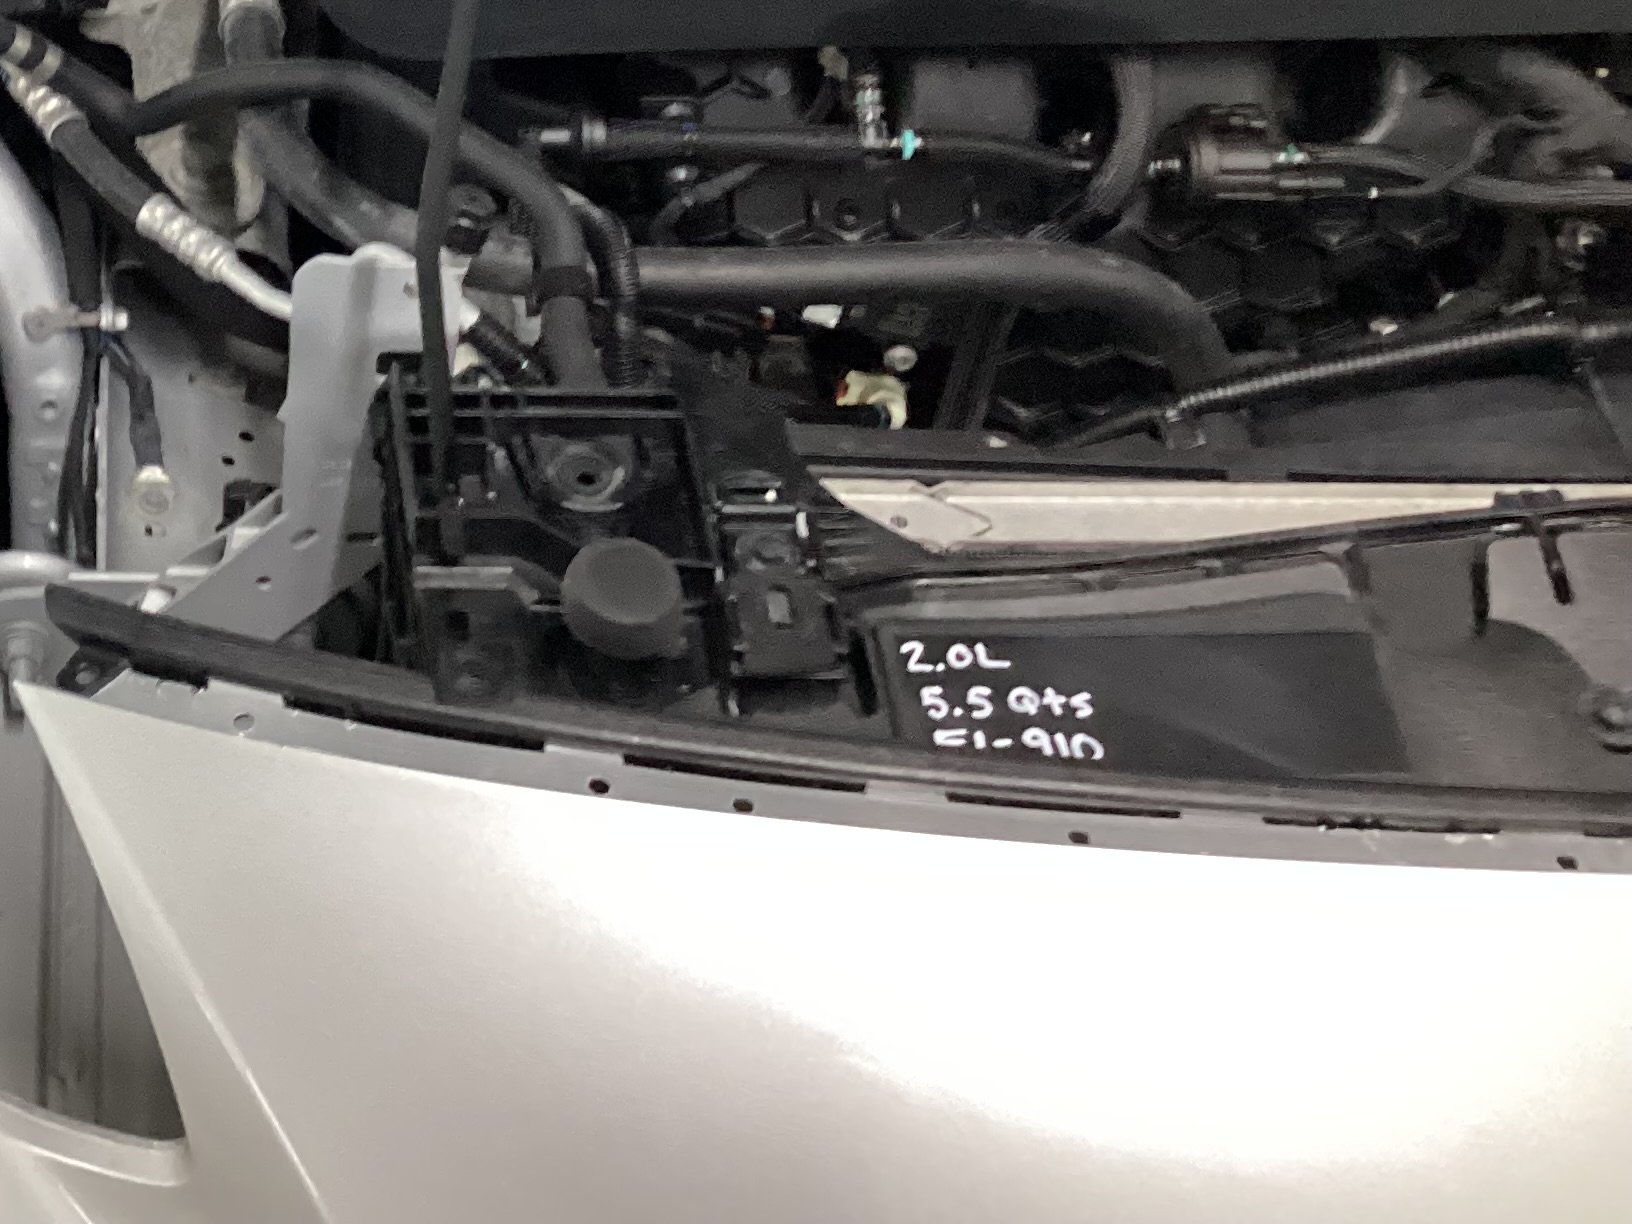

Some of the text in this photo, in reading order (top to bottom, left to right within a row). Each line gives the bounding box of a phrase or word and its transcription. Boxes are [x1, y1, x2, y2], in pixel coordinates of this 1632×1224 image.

[898, 639, 1013, 674] 2.0L
[918, 684, 1095, 721] 5.5 Qts
